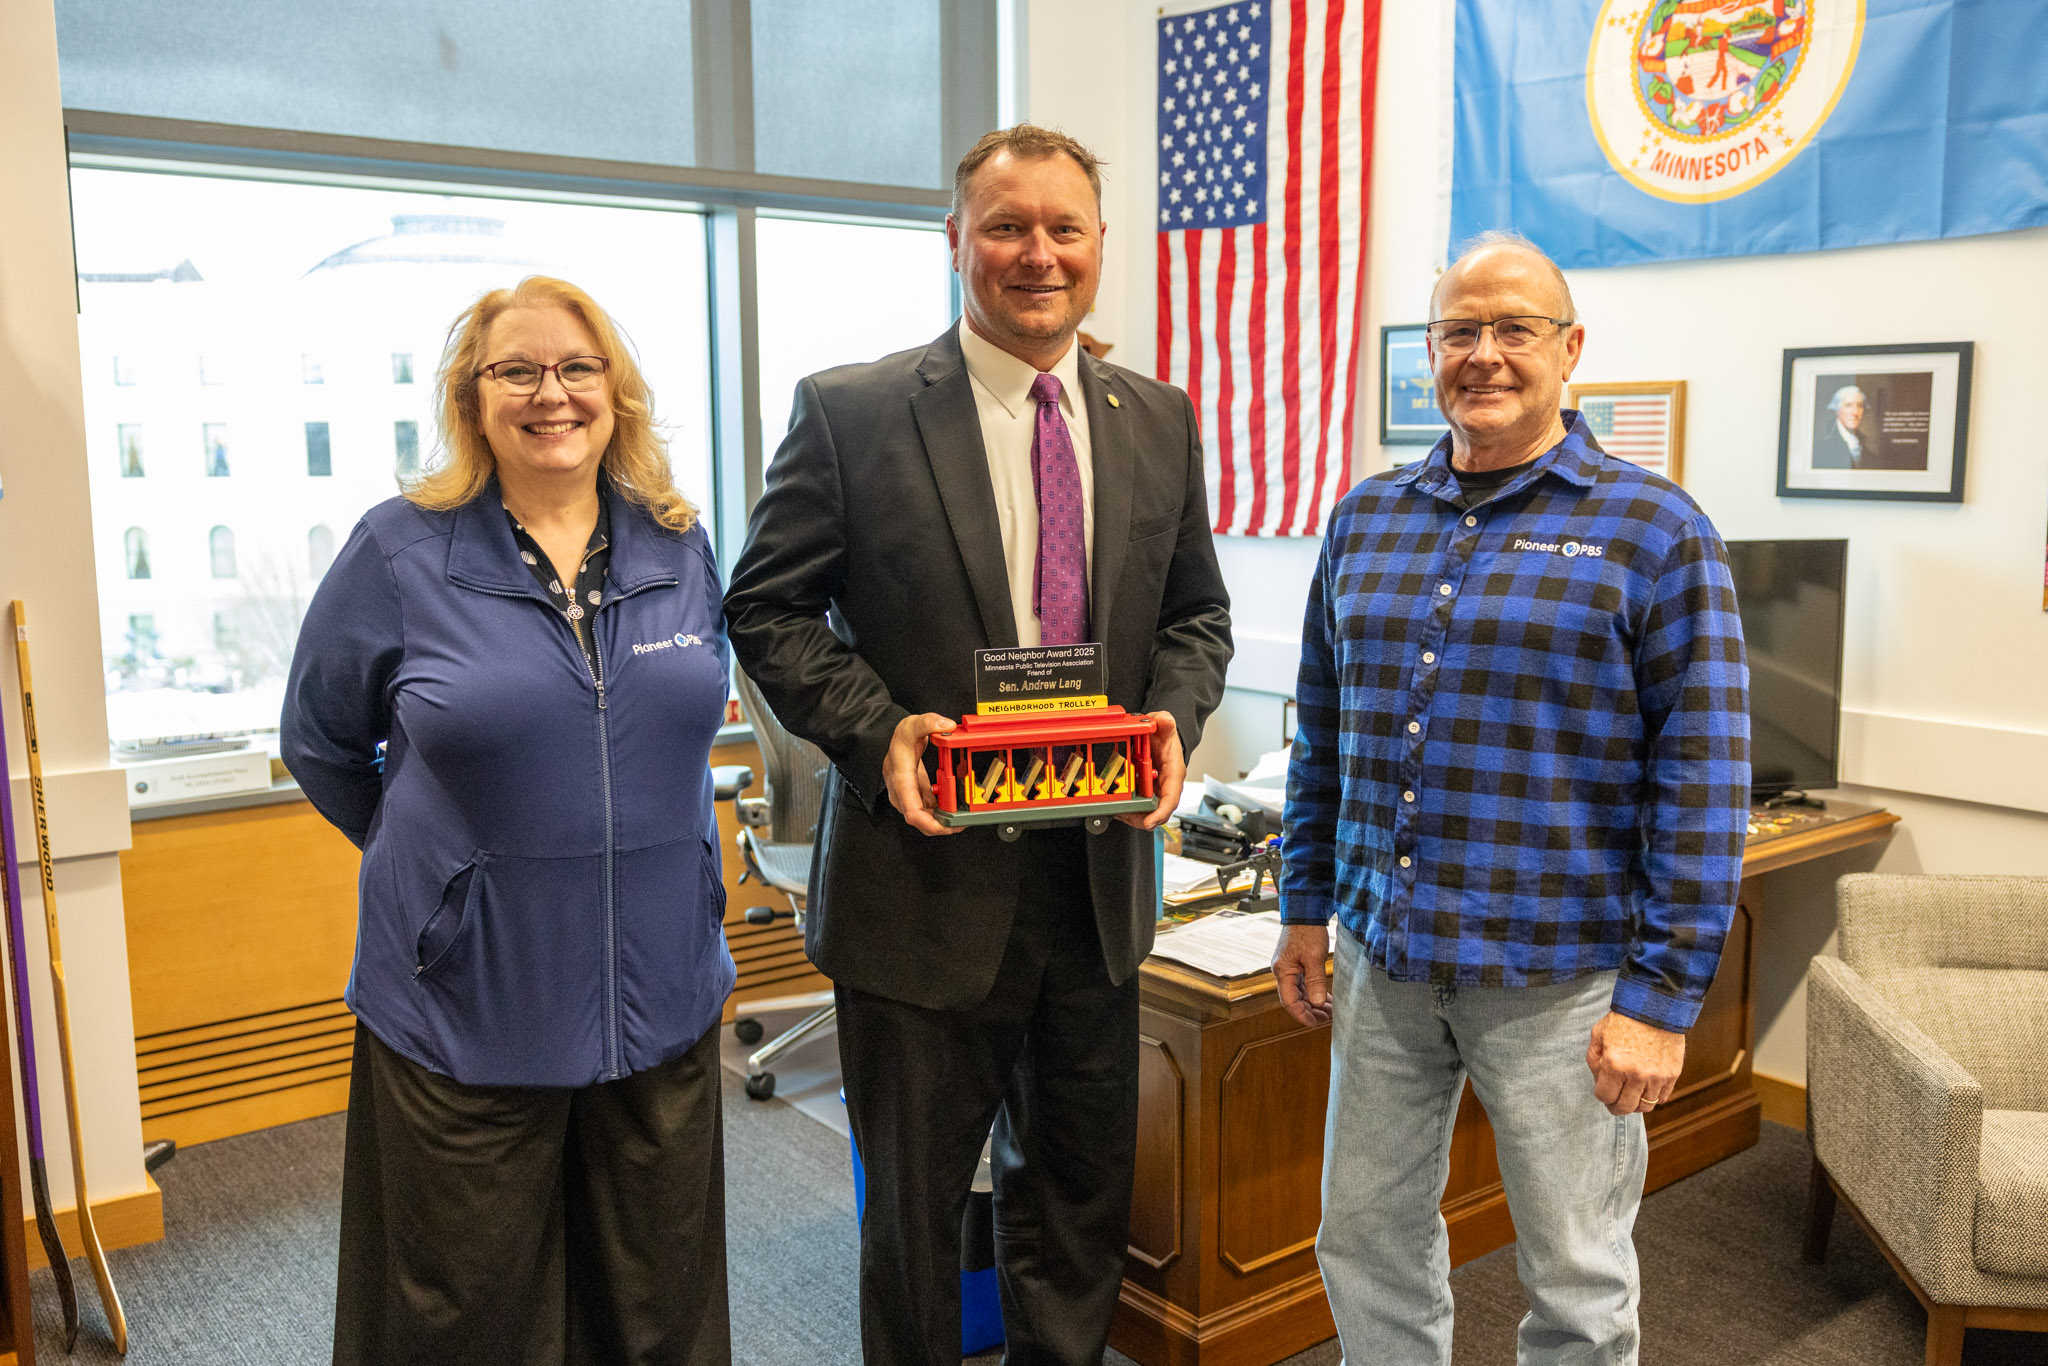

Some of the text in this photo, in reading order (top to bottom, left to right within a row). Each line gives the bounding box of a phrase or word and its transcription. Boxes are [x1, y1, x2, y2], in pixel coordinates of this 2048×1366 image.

[1651, 137, 1769, 181] MINNESOTA
[1513, 539, 1602, 557] Pioneer PBS
[632, 639, 673, 655] Pioneer
[983, 647, 1095, 661] Good Neighbor Award 2025
[1027, 669, 1045, 677] Friend
[999, 678, 1082, 692] Sen. Andrew Lang
[988, 700, 1097, 713] NEIGHBORHOOD TROLLEY
